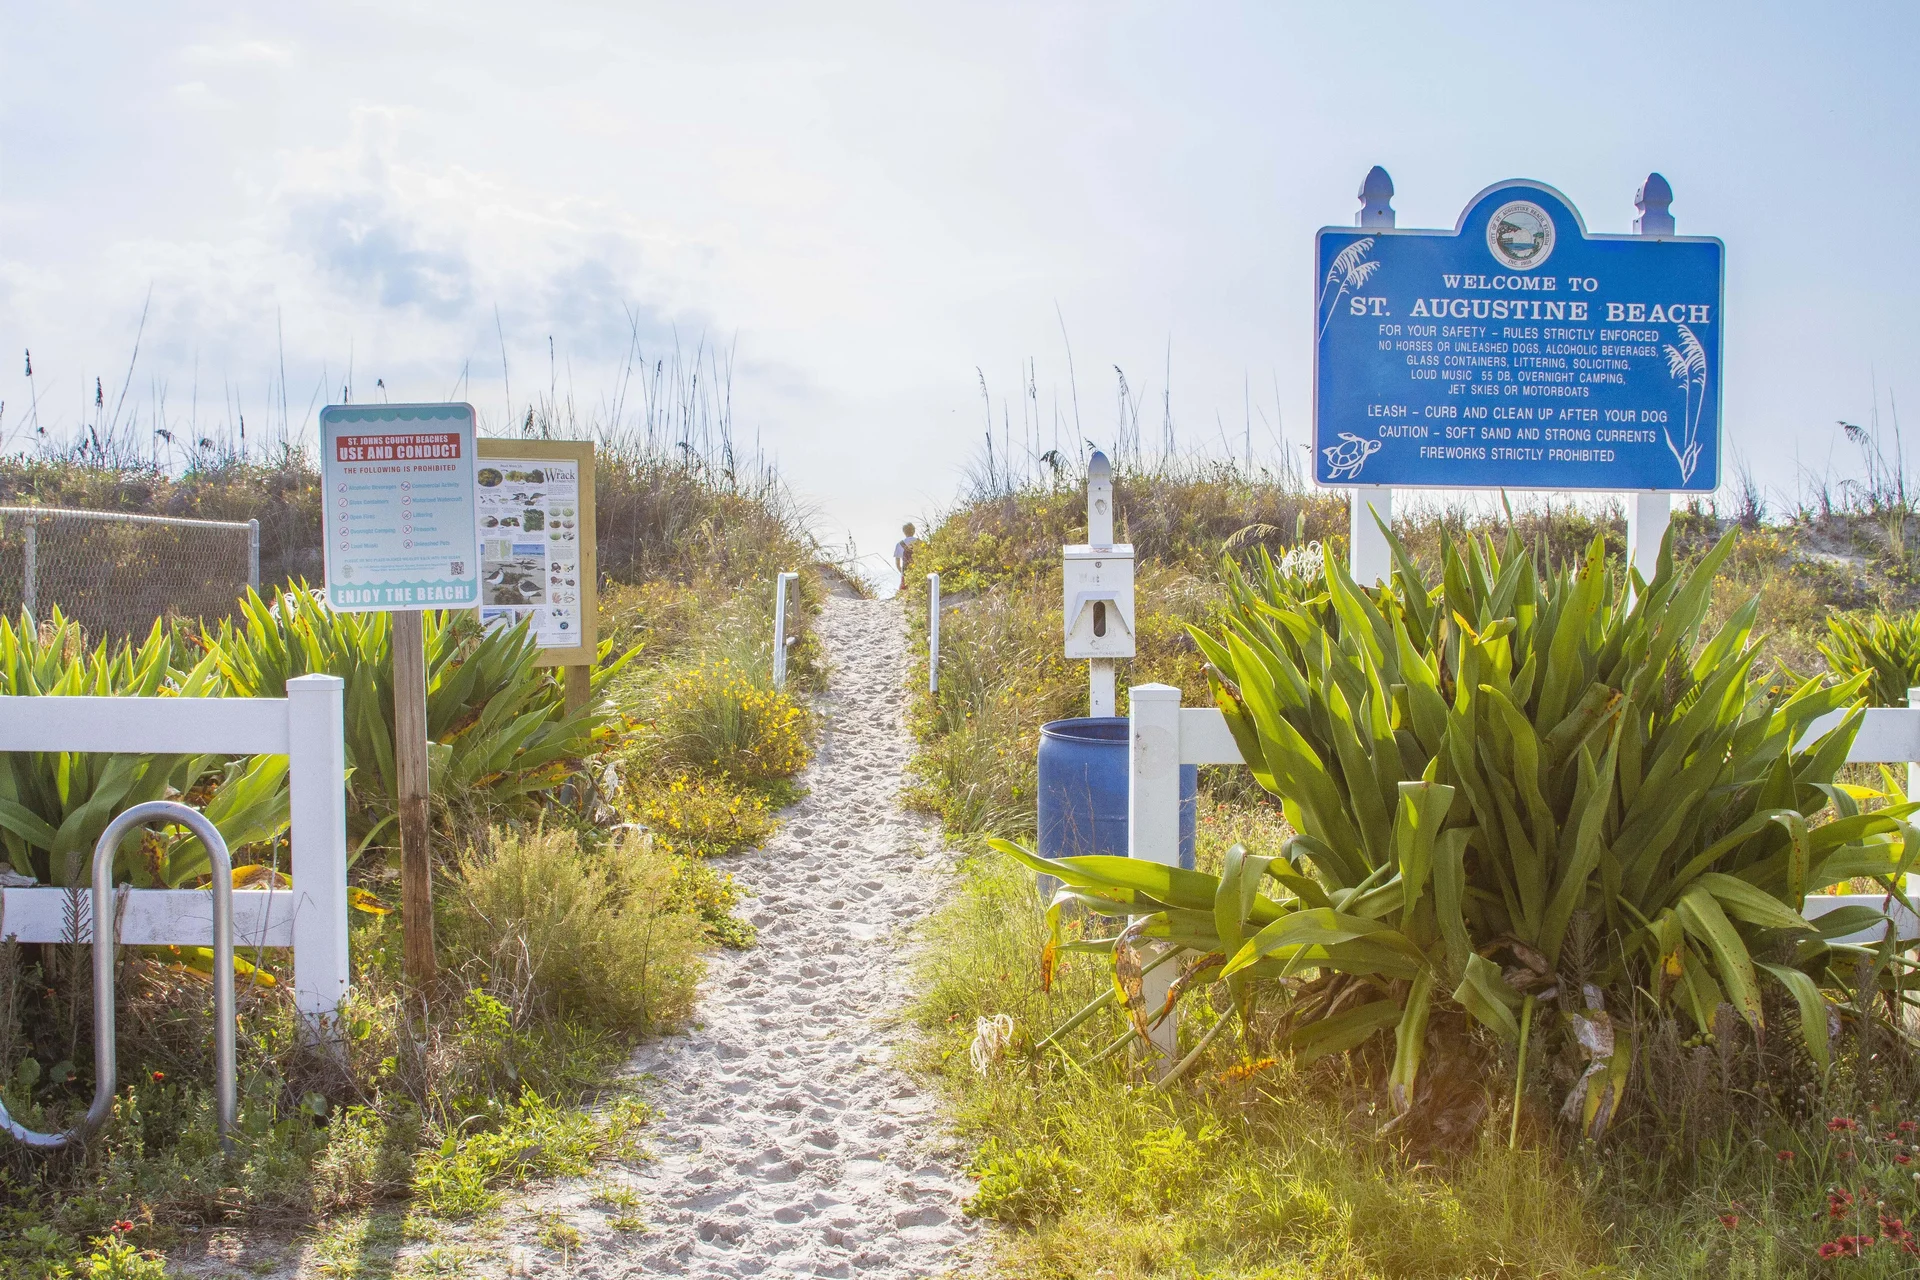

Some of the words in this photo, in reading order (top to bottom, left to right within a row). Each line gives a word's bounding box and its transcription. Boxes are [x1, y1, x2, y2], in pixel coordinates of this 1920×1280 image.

[1443, 275, 1555, 290] WELCOME
[1569, 278, 1598, 292] TO
[1351, 297, 1390, 316] ST.
[1410, 299, 1587, 320] AUGUSTINE
[1606, 303, 1709, 323] BEACH
[1380, 325, 1401, 335] FOR
[1408, 325, 1436, 336] YOUR
[1442, 326, 1485, 337] SAFETY
[1504, 327, 1538, 339] RULES
[1544, 328, 1594, 340] STRICTLY
[1601, 330, 1658, 341] ENFORCED
[1379, 341, 1391, 350] NO
[1397, 341, 1432, 351] HORSES
[1438, 342, 1450, 351] OR
[1455, 342, 1508, 352] UNLEASHED
[1513, 343, 1540, 355] DOGS,
[1546, 344, 1597, 355] ALCOHOLIC
[1602, 346, 1658, 358] BEVERAGES,
[1407, 355, 1439, 365] GLASS
[1444, 356, 1509, 368] CONTAINERS,
[1514, 357, 1568, 370] LITTERING,
[1574, 359, 1631, 372] SOLICITING,
[1412, 369, 1436, 379] LOUD
[1442, 370, 1471, 380] MUSIC
[1482, 371, 1492, 380] 55
[1497, 371, 1513, 383] DB,
[1518, 371, 1574, 382] OVERNIGHT
[1580, 373, 1626, 385] CAMPING,
[1448, 384, 1465, 394] JET
[1471, 385, 1499, 395] SKIES
[1504, 385, 1517, 395] OR
[1523, 386, 1589, 397] MOTORBOATS
[1368, 405, 1406, 417] LEASH
[1425, 406, 1457, 418] CURB
[1464, 407, 1487, 418] AND
[1494, 407, 1532, 419] CLEAN
[1539, 408, 1553, 420] UP
[1560, 409, 1597, 420] AFTER
[1605, 410, 1635, 421] YOUR
[1642, 411, 1667, 422] DOG
[347, 437, 359, 446] ST.
[360, 437, 383, 445] JOHNS
[385, 436, 414, 444] COUNTY
[415, 435, 448, 443] BEACHES
[1379, 425, 1428, 438] CAUTION
[1446, 427, 1475, 438] SOFT
[1482, 427, 1511, 439] SAND
[1517, 428, 1539, 439] AND
[1545, 429, 1590, 441] STRONG
[1596, 430, 1655, 442] CURRENTS
[339, 447, 364, 460] USE
[367, 446, 393, 460] AND
[396, 444, 457, 459] CONDUCT
[1421, 447, 1485, 459] FIREWORKS
[1492, 448, 1543, 460] STRICTLY
[1549, 449, 1614, 461] PROHIBITED
[360, 466, 401, 474] FOLLOWING
[413, 464, 456, 472] PROHIBITED
[544, 468, 575, 482] Wrack
[337, 589, 380, 604] ENJOY
[385, 588, 412, 602] THE
[416, 586, 470, 601] BEACH!
